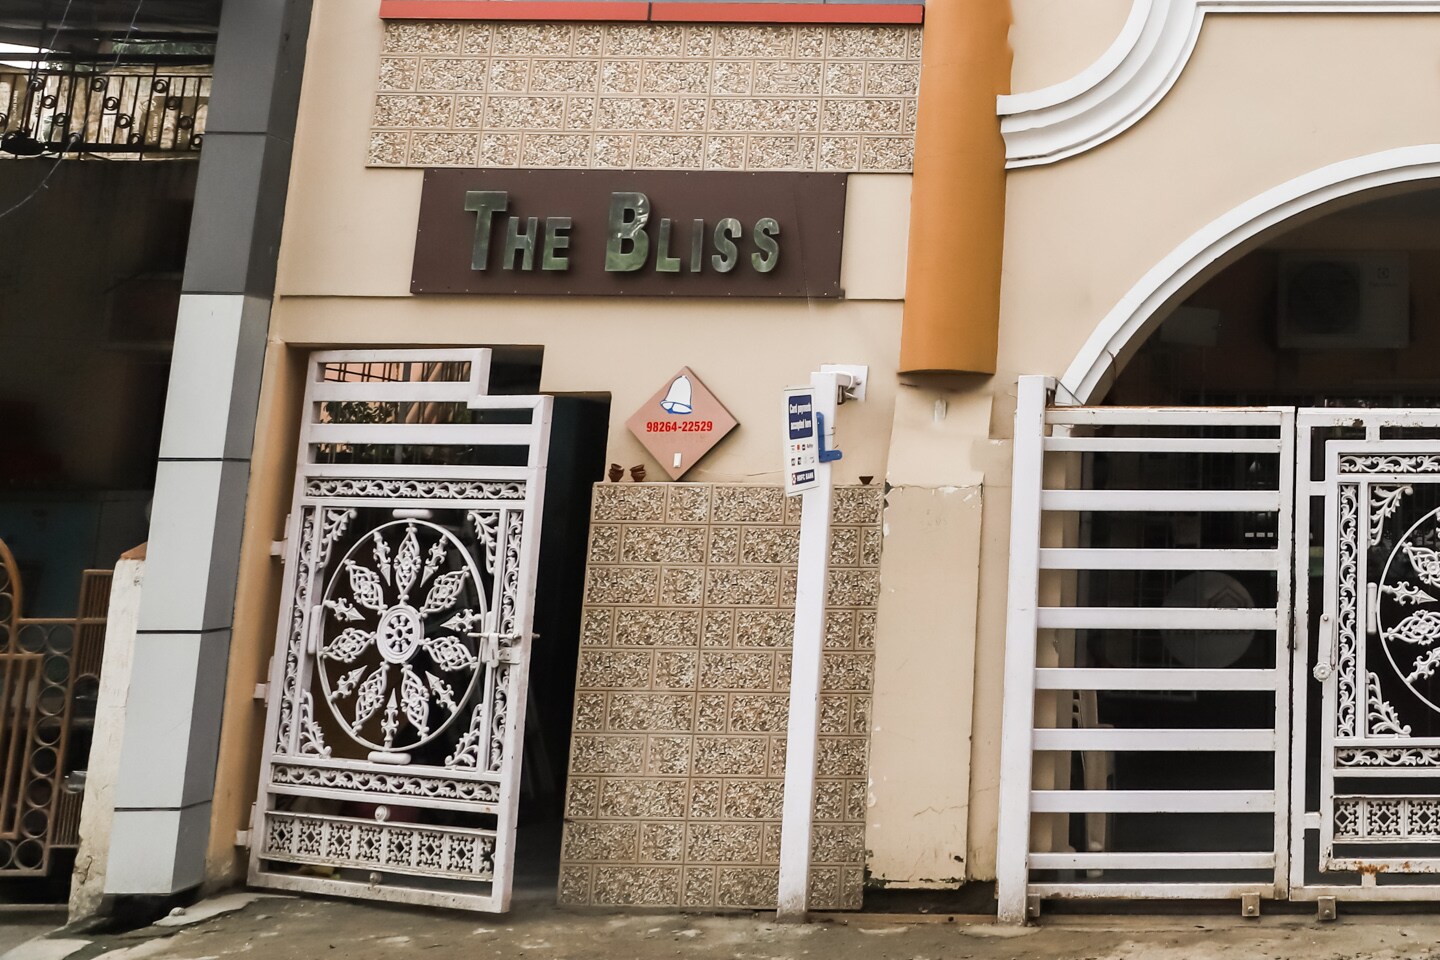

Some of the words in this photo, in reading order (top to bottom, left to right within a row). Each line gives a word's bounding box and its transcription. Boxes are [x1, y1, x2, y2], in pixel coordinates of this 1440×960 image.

[464, 190, 573, 271] THE
[604, 191, 781, 273] BLISS
[646, 420, 713, 433] 98264-22529
